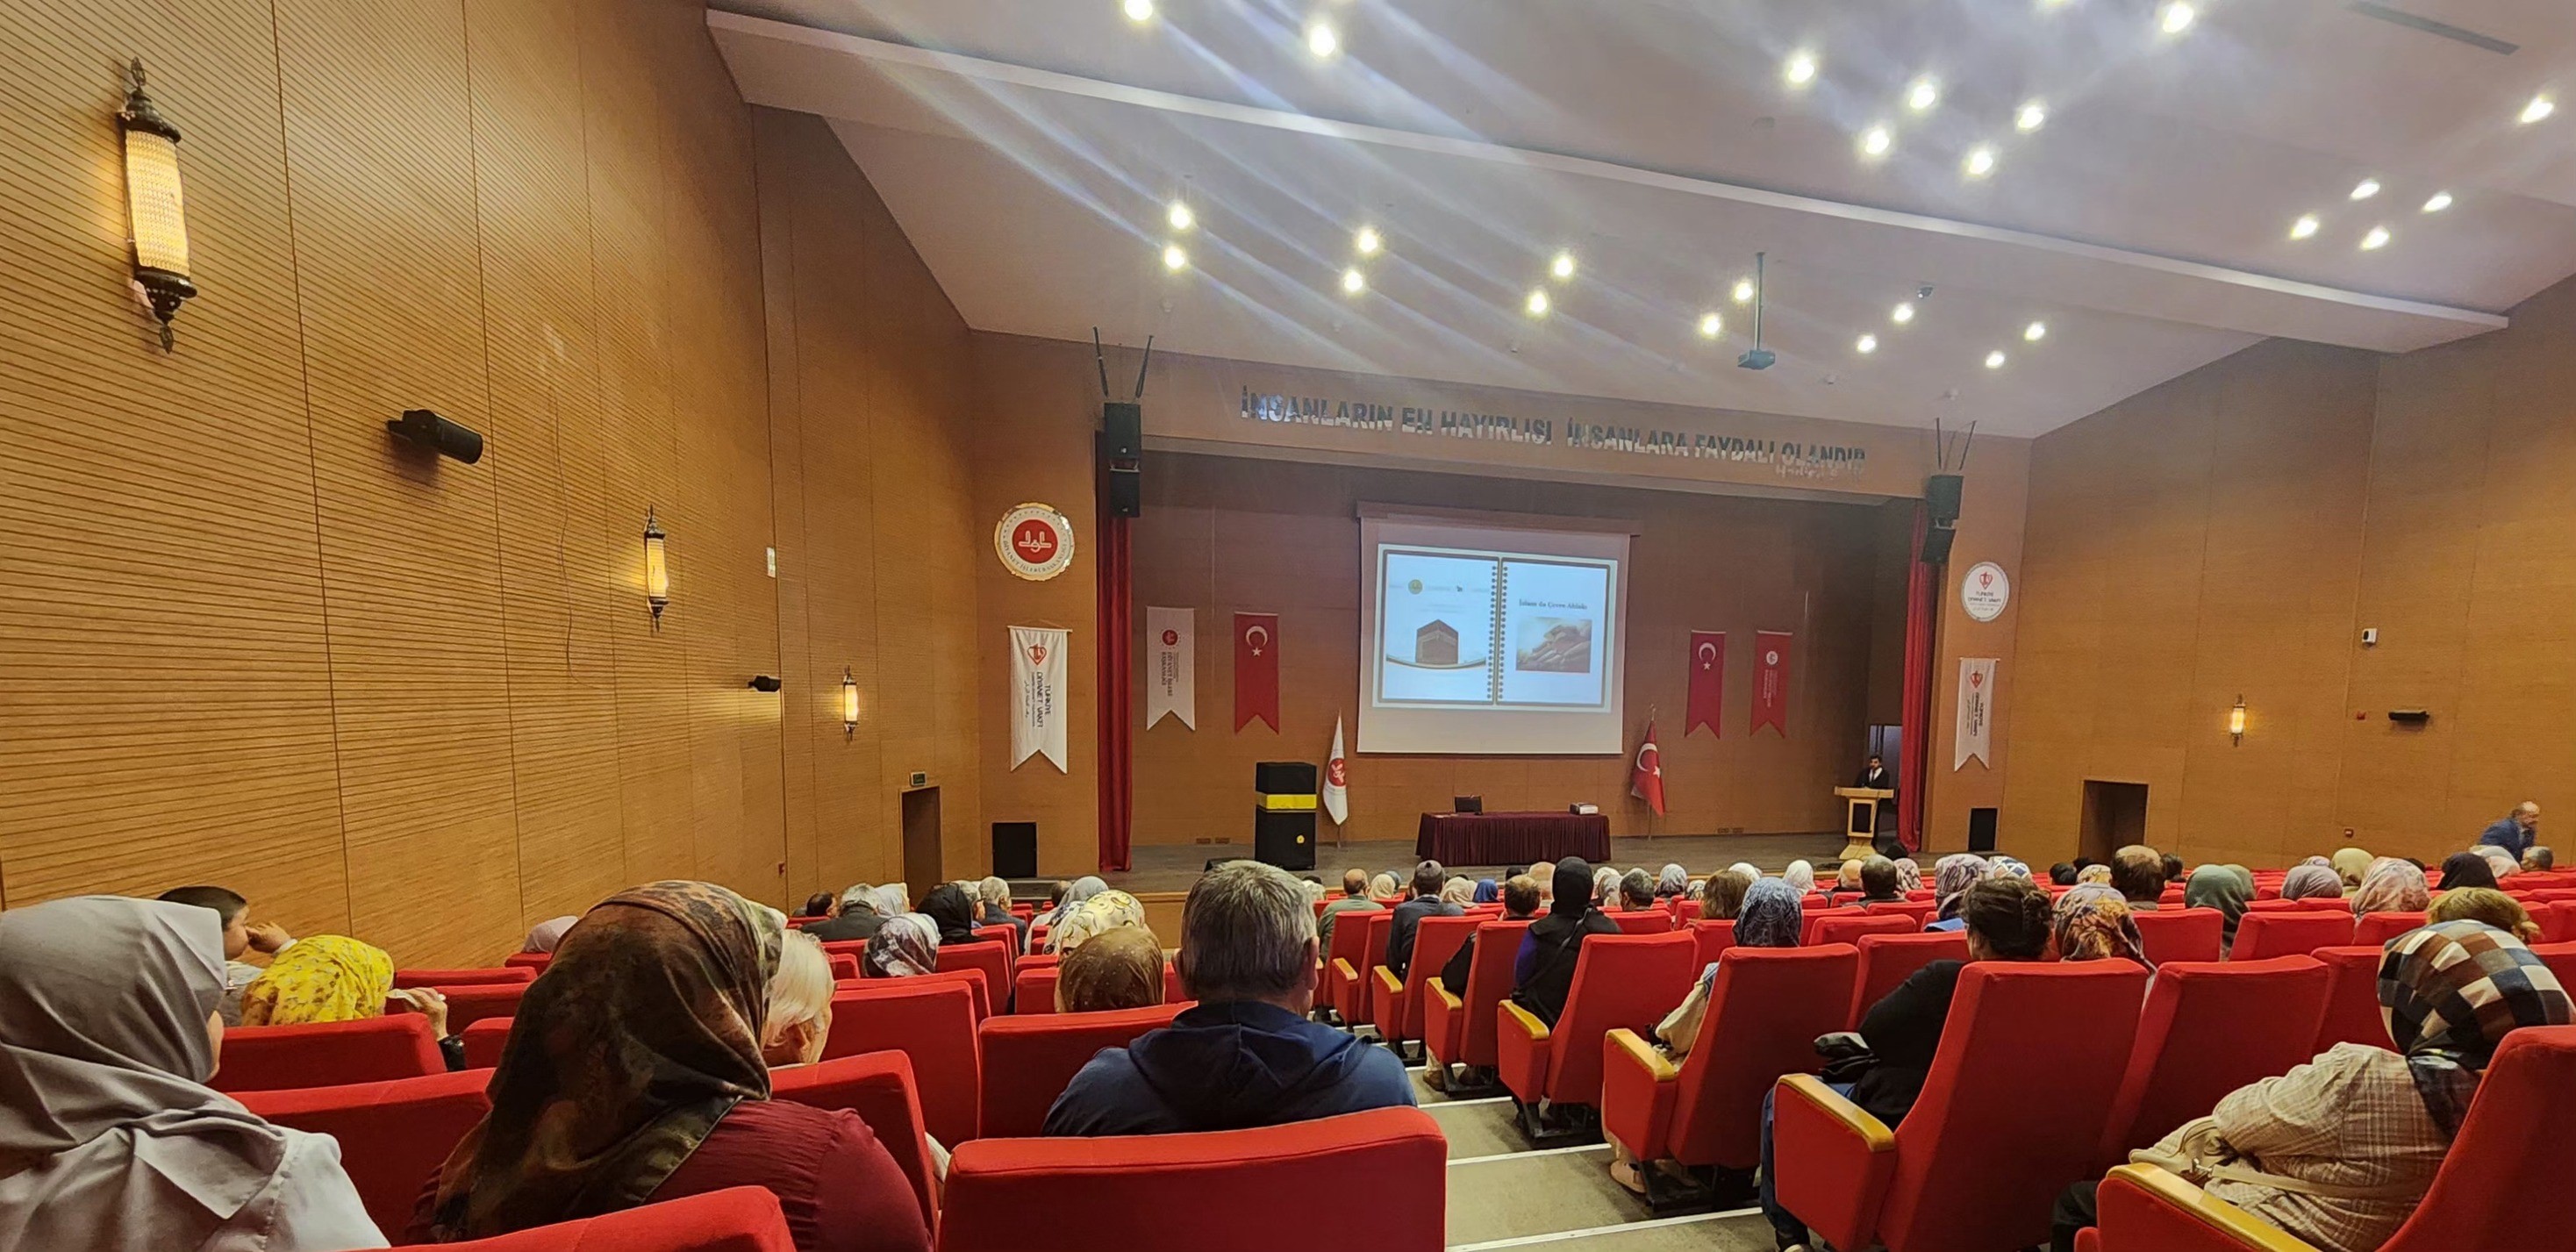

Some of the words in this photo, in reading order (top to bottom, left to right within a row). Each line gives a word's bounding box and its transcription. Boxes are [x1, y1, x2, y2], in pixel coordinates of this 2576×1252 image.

[1241, 384, 1393, 432] İNSANLARIN
[1401, 407, 1433, 435] EN
[1441, 411, 1553, 446] HAYIRLISI
[1567, 417, 1689, 457] İNSANLARA
[1694, 433, 1775, 464] FAYDALI
